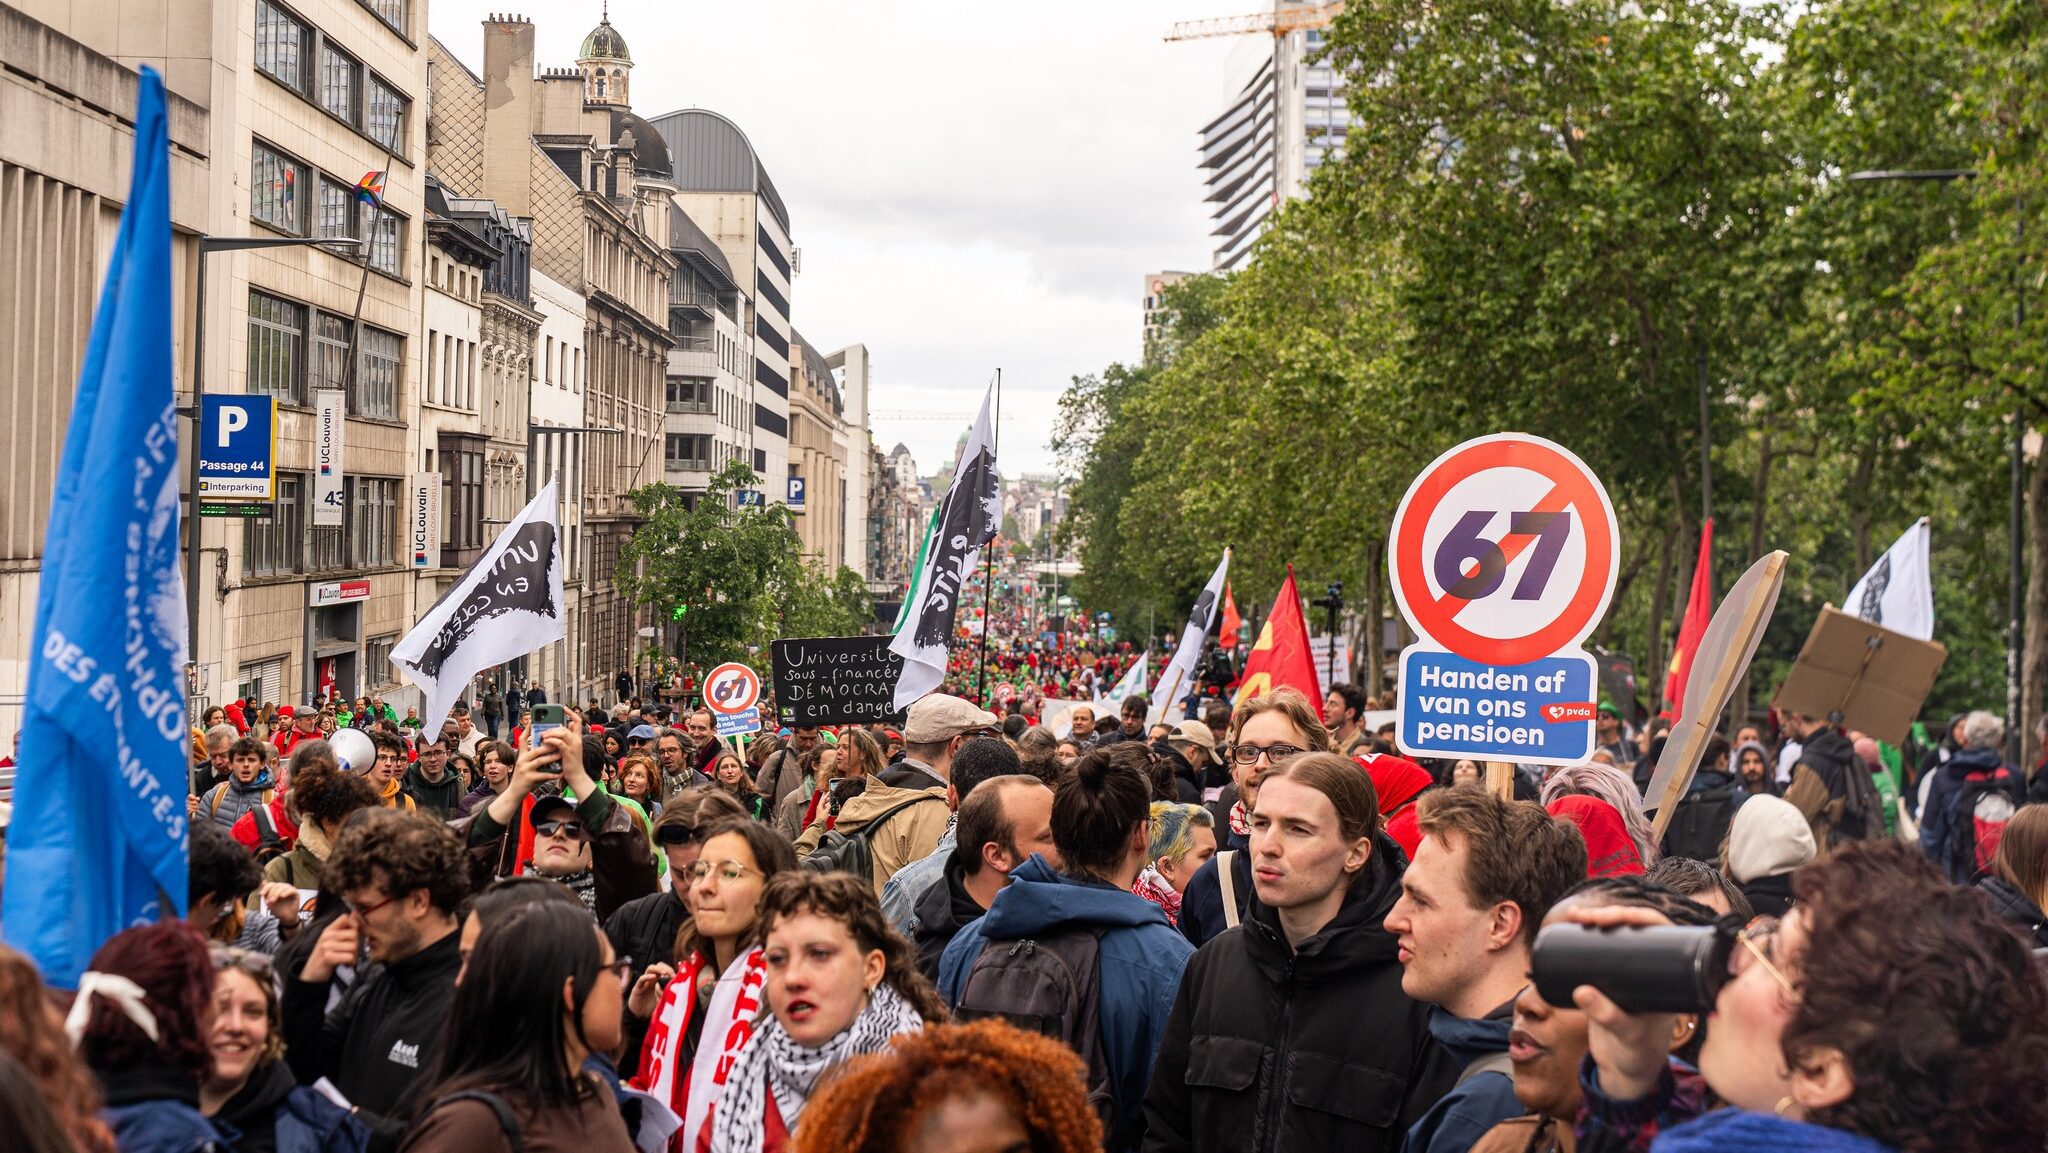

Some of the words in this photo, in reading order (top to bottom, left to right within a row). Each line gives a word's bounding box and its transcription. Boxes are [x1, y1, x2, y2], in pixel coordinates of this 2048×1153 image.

[218, 405, 248, 447] P
[321, 408, 331, 464] UCLouvain
[199, 460, 248, 473] Passage
[250, 461, 265, 471] 44
[209, 482, 265, 493] Interparking
[790, 480, 803, 498] P
[415, 487, 427, 551] UCLouvain
[1434, 510, 1571, 601] 67
[42, 630, 98, 684] DES
[715, 678, 747, 701] 67
[1420, 665, 1528, 692] Handen
[1534, 669, 1566, 693] af
[730, 712, 754, 720] touche
[807, 704, 830, 717] en
[843, 701, 894, 718] dange
[1419, 695, 1469, 714] van
[1476, 700, 1526, 718] ons
[1566, 707, 1591, 718] pvda
[717, 725, 748, 734] pensions
[1417, 719, 1545, 746] pensioen
